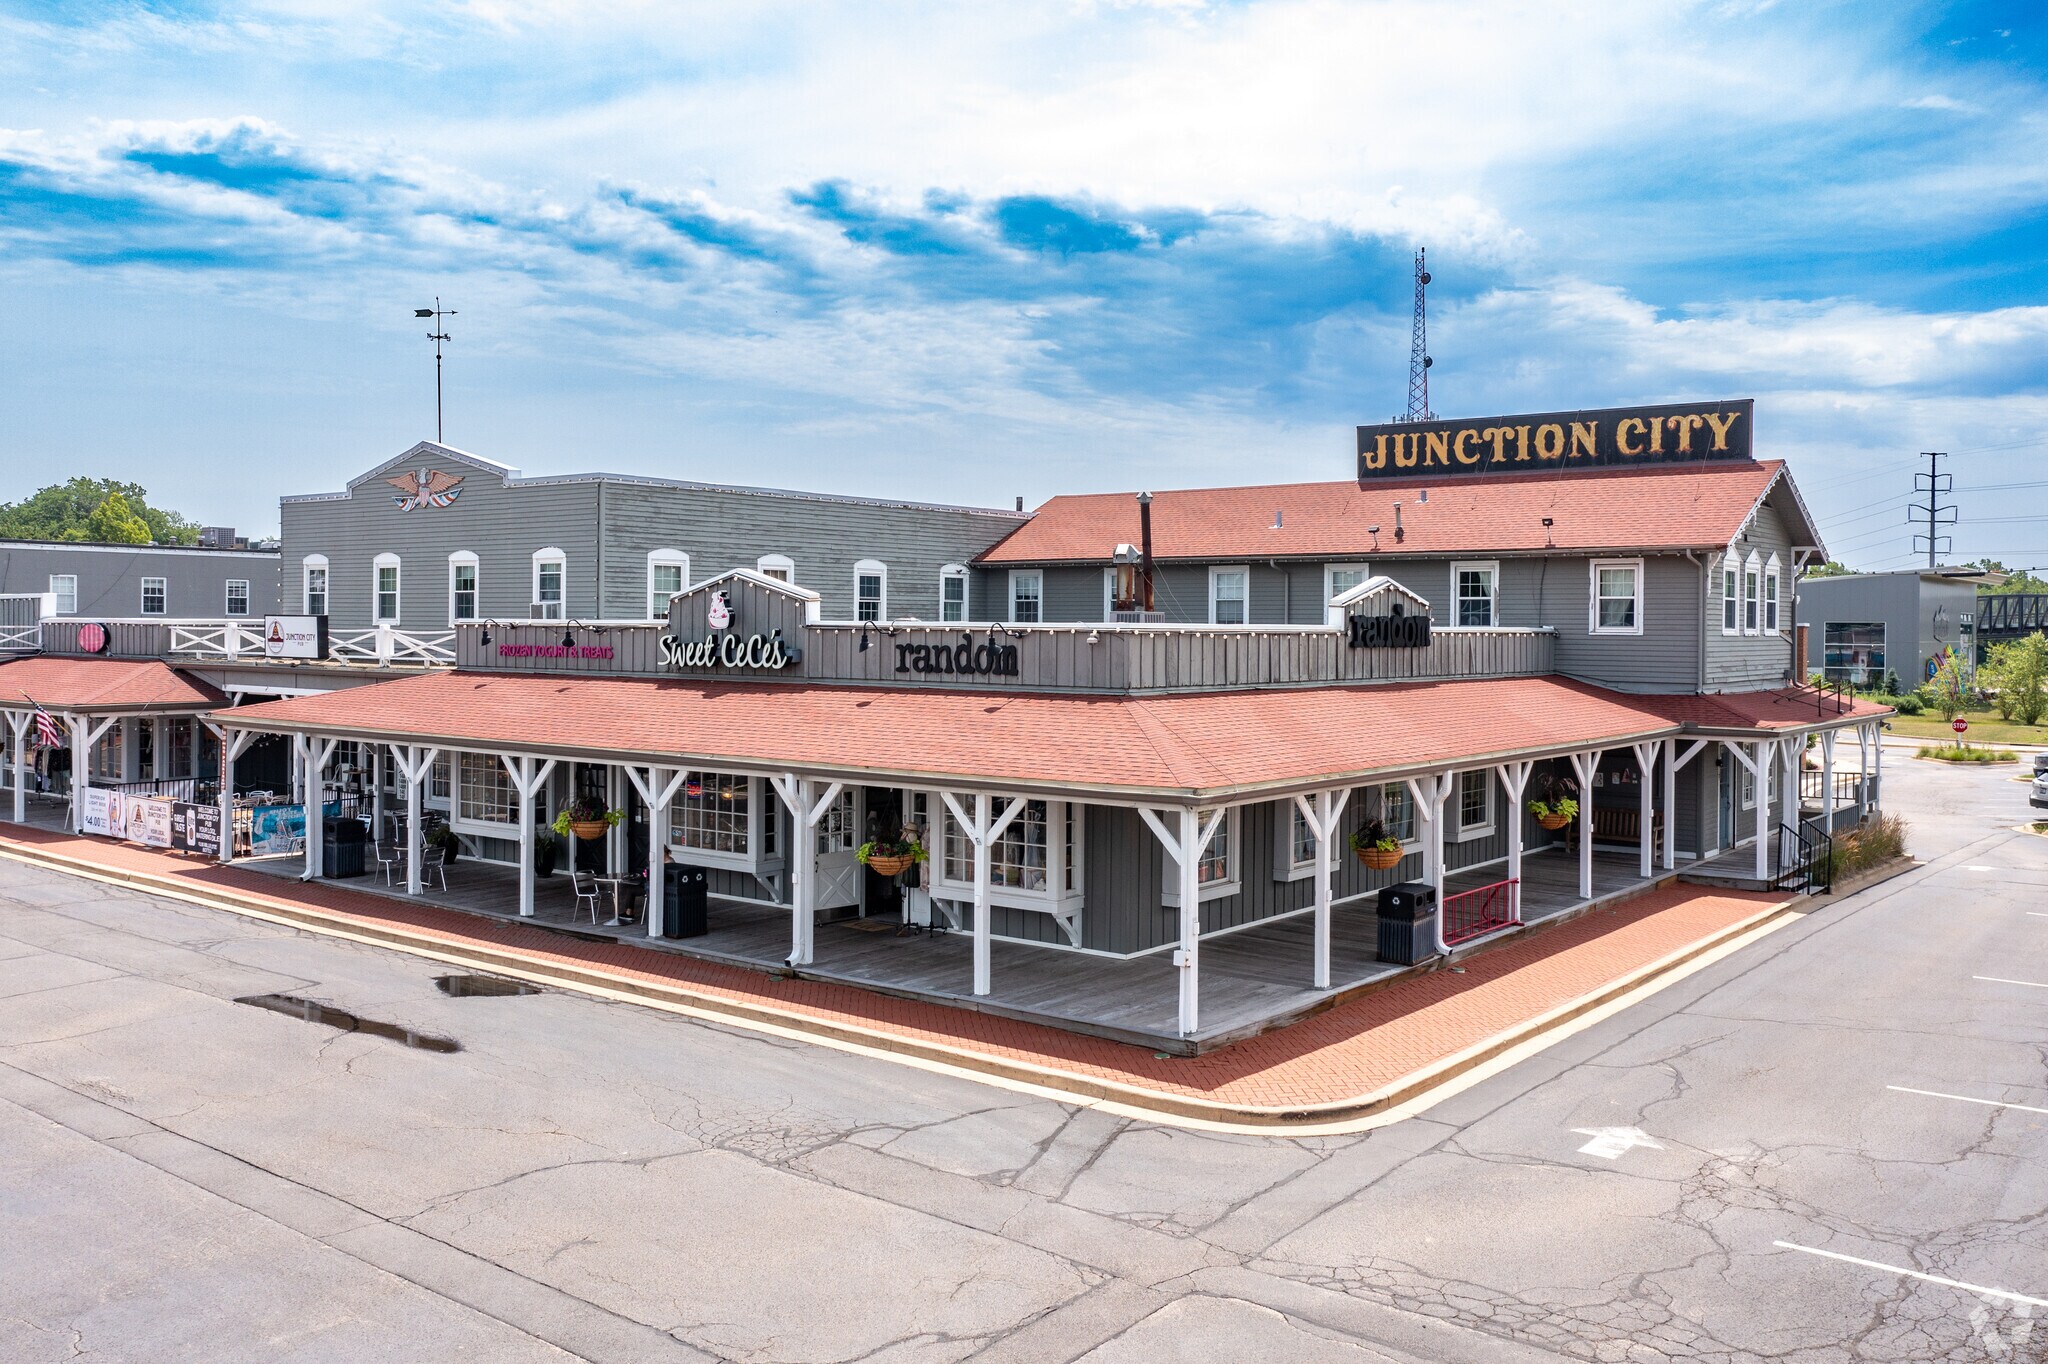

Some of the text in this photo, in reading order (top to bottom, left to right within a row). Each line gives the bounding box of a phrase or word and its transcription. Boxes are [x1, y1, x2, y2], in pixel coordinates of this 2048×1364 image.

[1362, 411, 1742, 469] JUNCTION CITY
[1349, 604, 1431, 648] random
[499, 644, 614, 660] FROZEN YOGURT & TREATS
[657, 628, 788, 670] Sweet CeCe's
[895, 633, 1019, 677] random
[85, 815, 101, 828] $4.00
